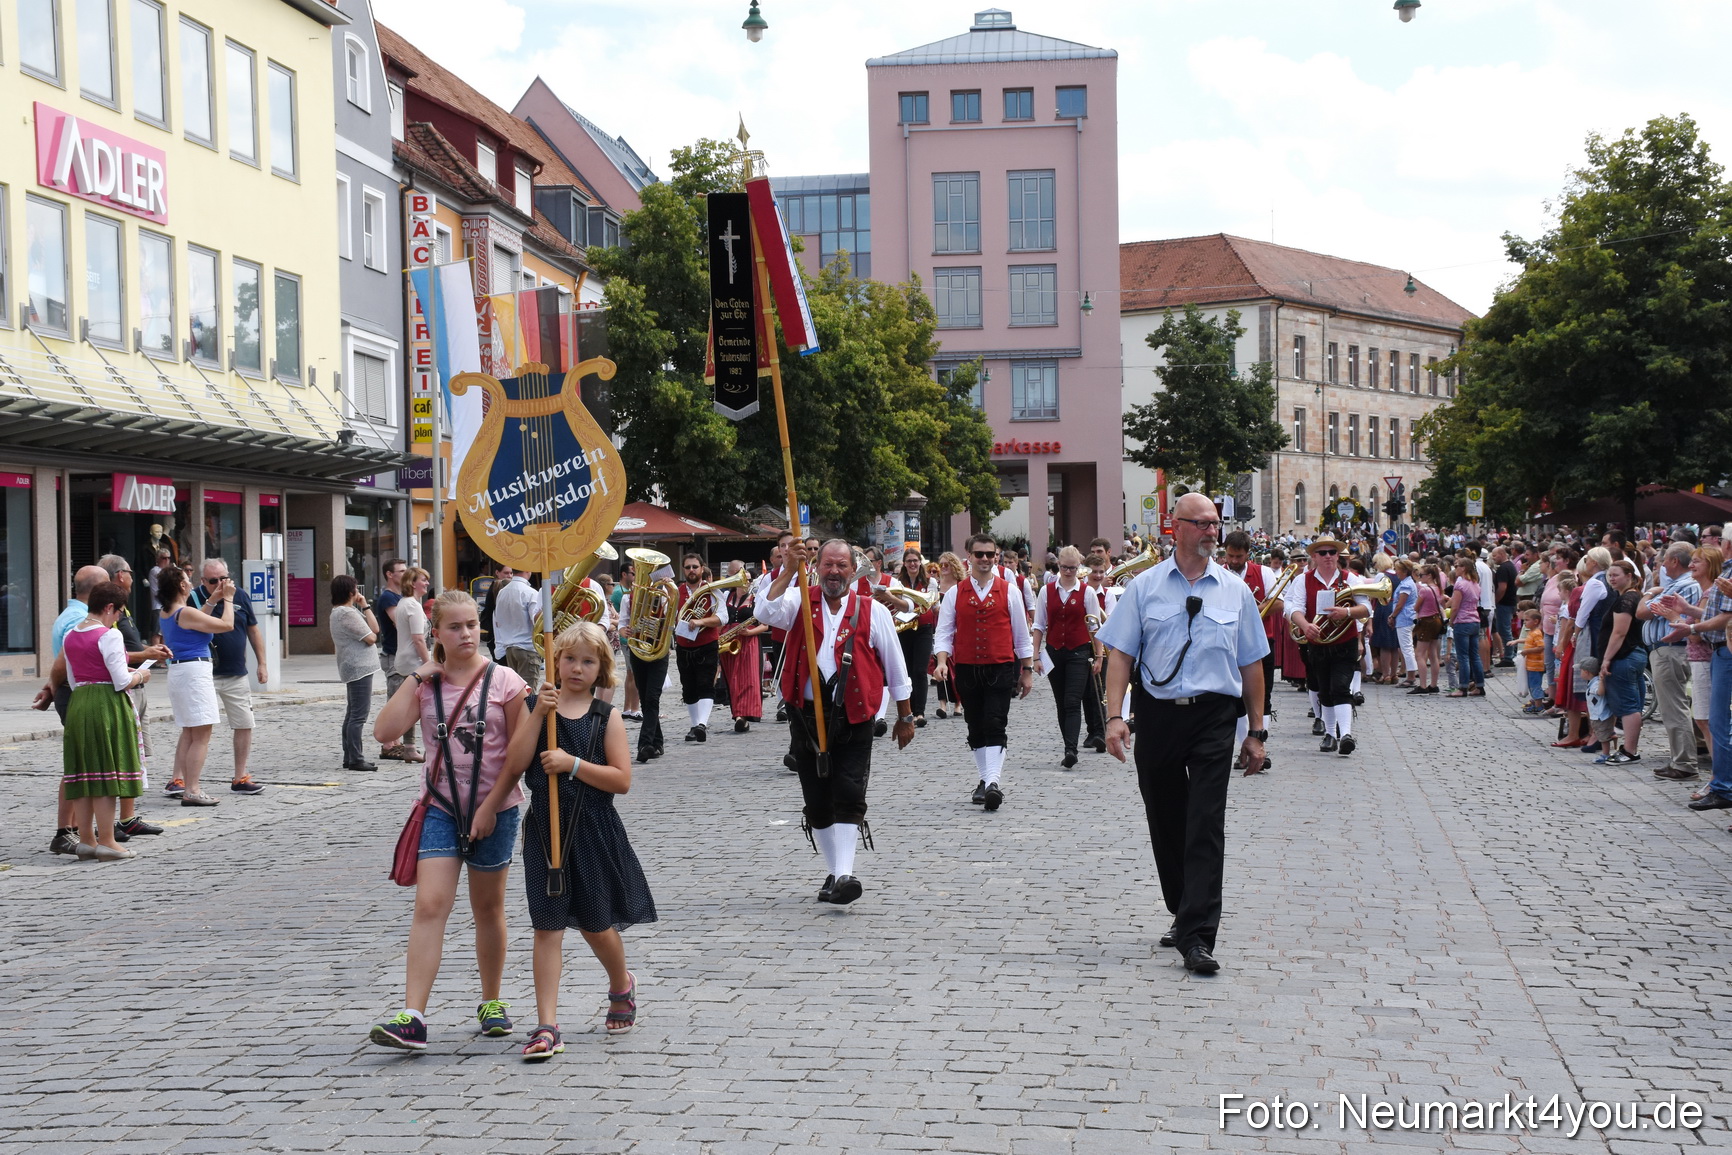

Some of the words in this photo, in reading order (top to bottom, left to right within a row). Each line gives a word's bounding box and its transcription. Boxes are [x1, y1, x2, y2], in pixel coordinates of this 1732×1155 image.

[54, 115, 167, 216] ADLER
[413, 195, 432, 391] BÄCREI
[718, 335, 751, 347] Gemeinde
[414, 398, 433, 414] caf
[121, 475, 177, 512] ADLER
[469, 446, 607, 514] Musikverein
[484, 467, 609, 537] Seubersdorf
[253, 576, 263, 590] P
